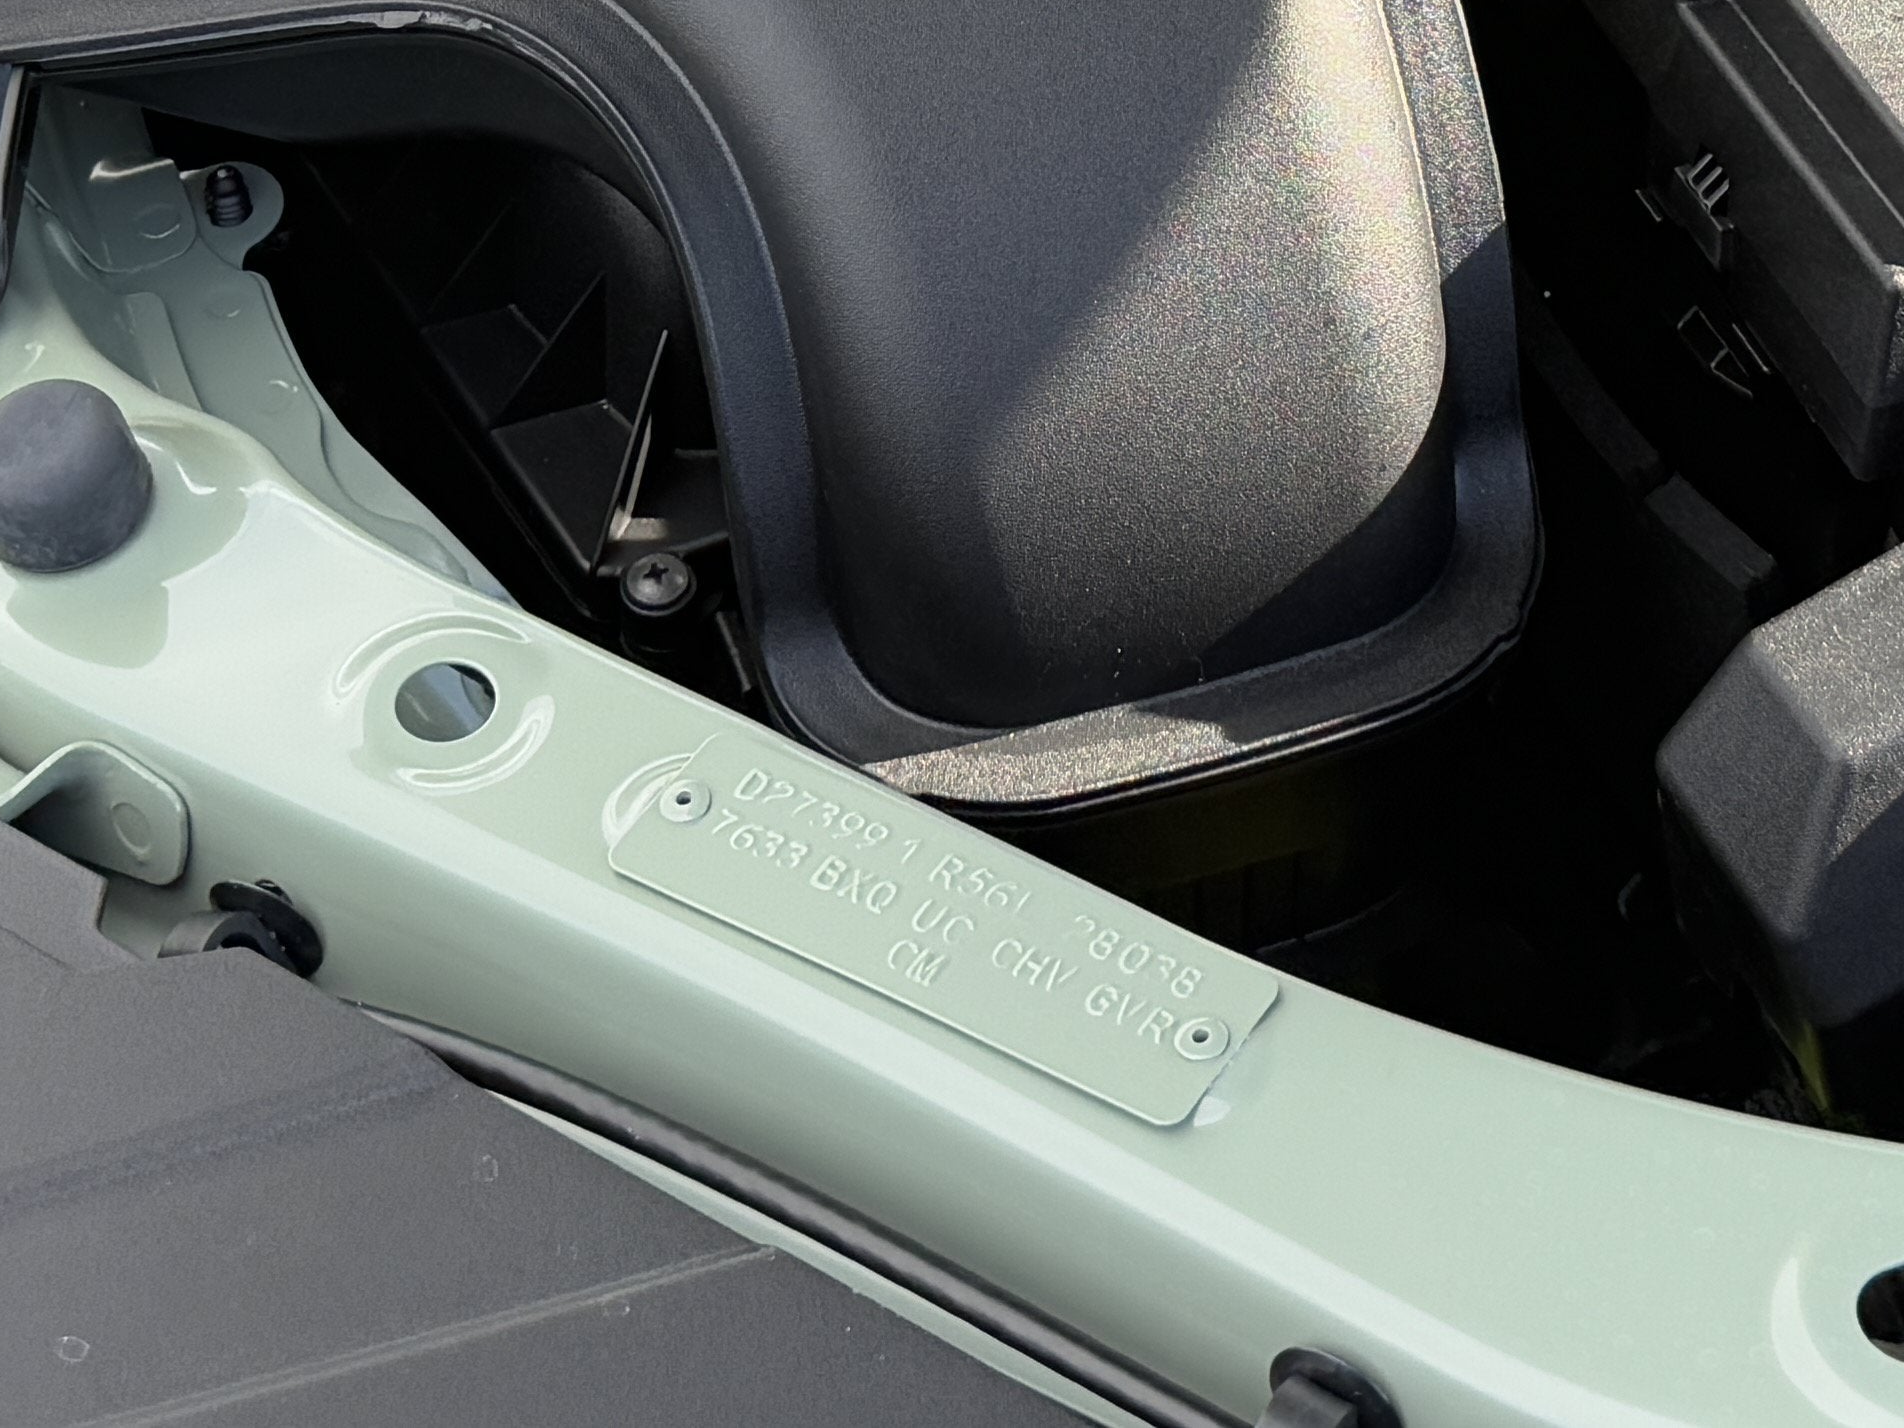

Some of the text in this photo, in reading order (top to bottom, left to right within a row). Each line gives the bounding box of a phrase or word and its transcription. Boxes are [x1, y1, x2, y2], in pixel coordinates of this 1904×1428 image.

[711, 808, 809, 868] 7633
[809, 854, 898, 915] BXQ
[911, 898, 975, 944] UC
[991, 938, 1080, 992] CHV
